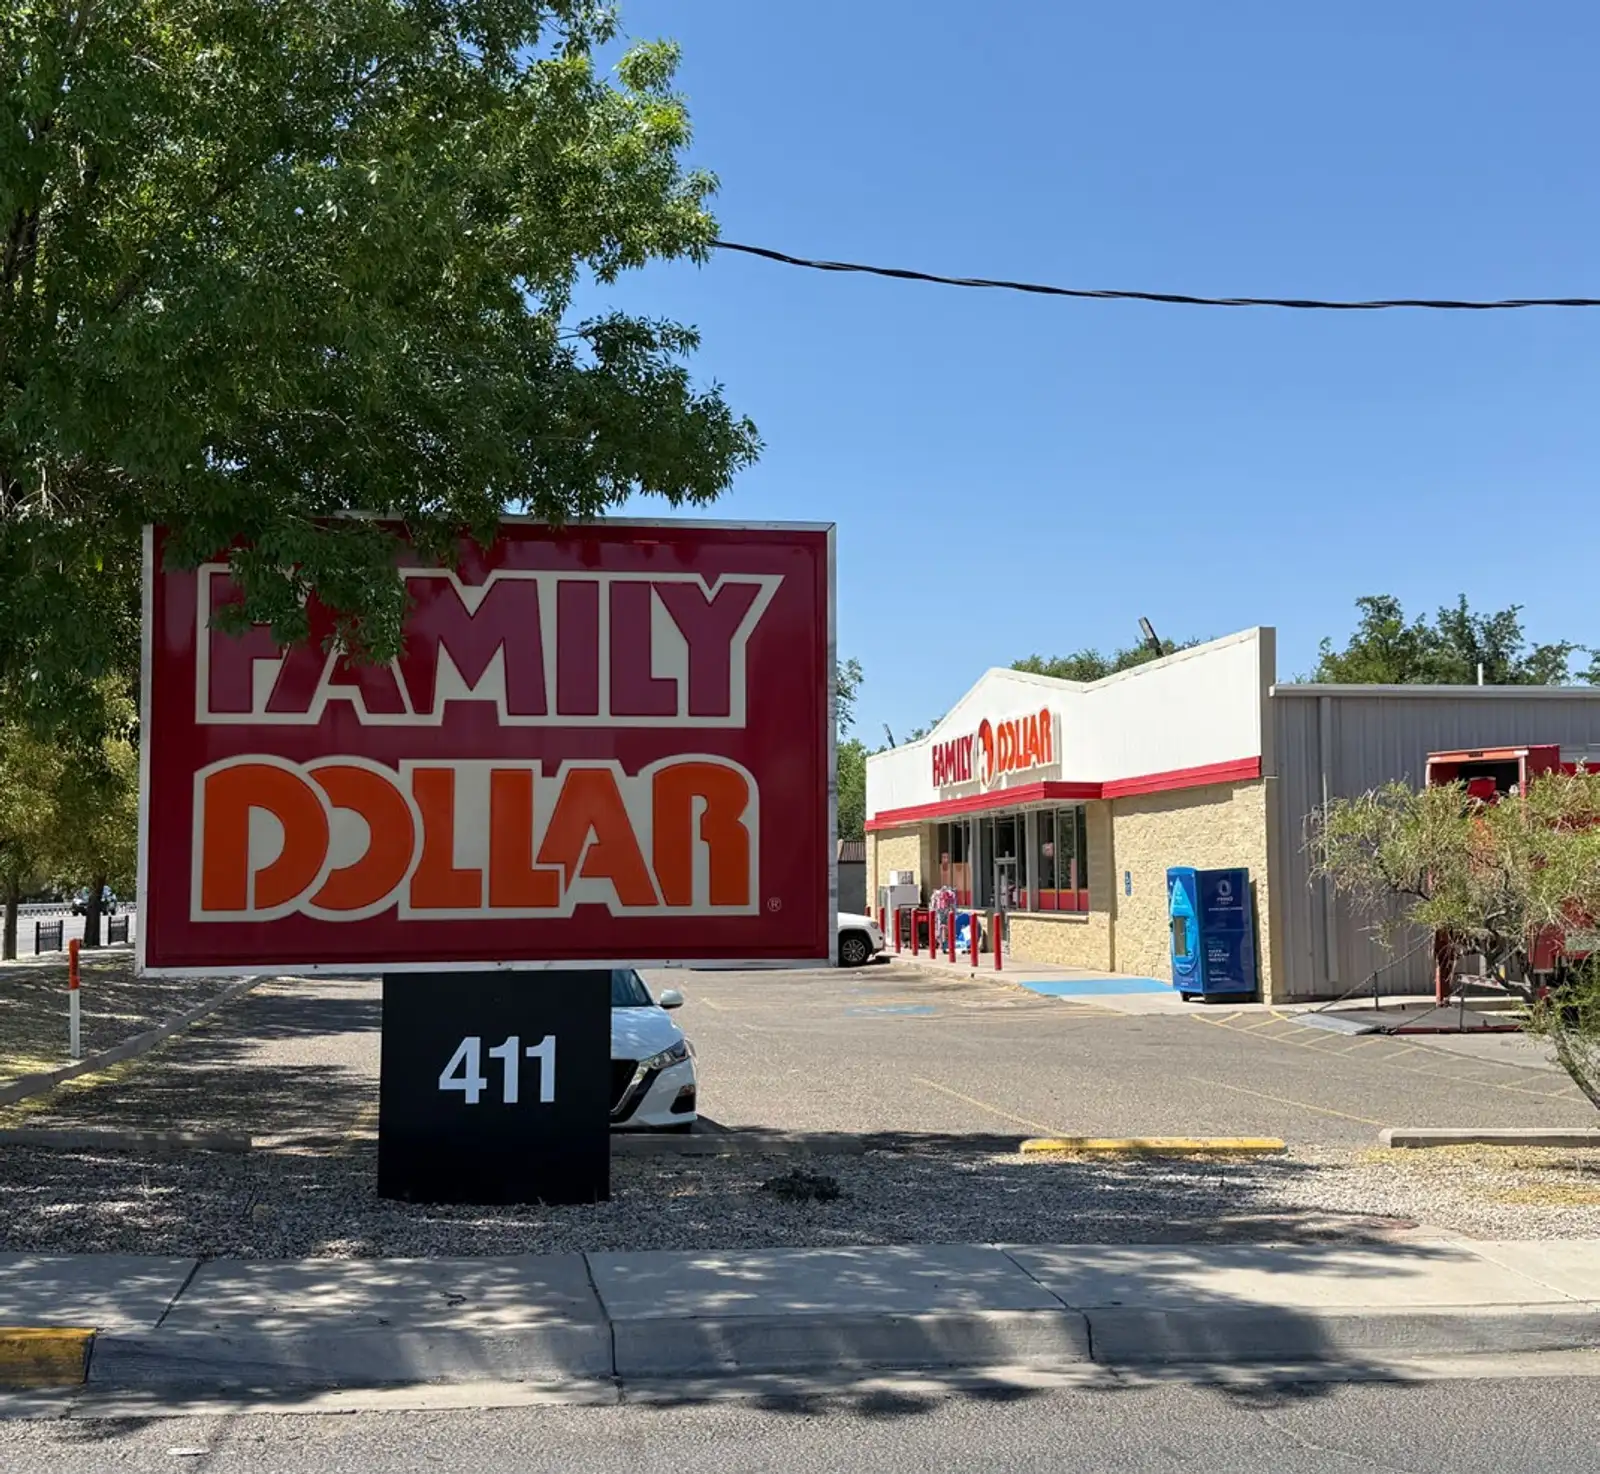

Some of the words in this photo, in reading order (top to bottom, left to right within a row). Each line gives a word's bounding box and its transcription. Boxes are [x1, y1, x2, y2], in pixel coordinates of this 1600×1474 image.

[196, 562, 784, 728] FAMILY
[932, 733, 974, 788] FAMILY
[997, 708, 1052, 773] DOLLAR
[190, 753, 760, 922] DOLLAR
[438, 1034, 556, 1104] 411
